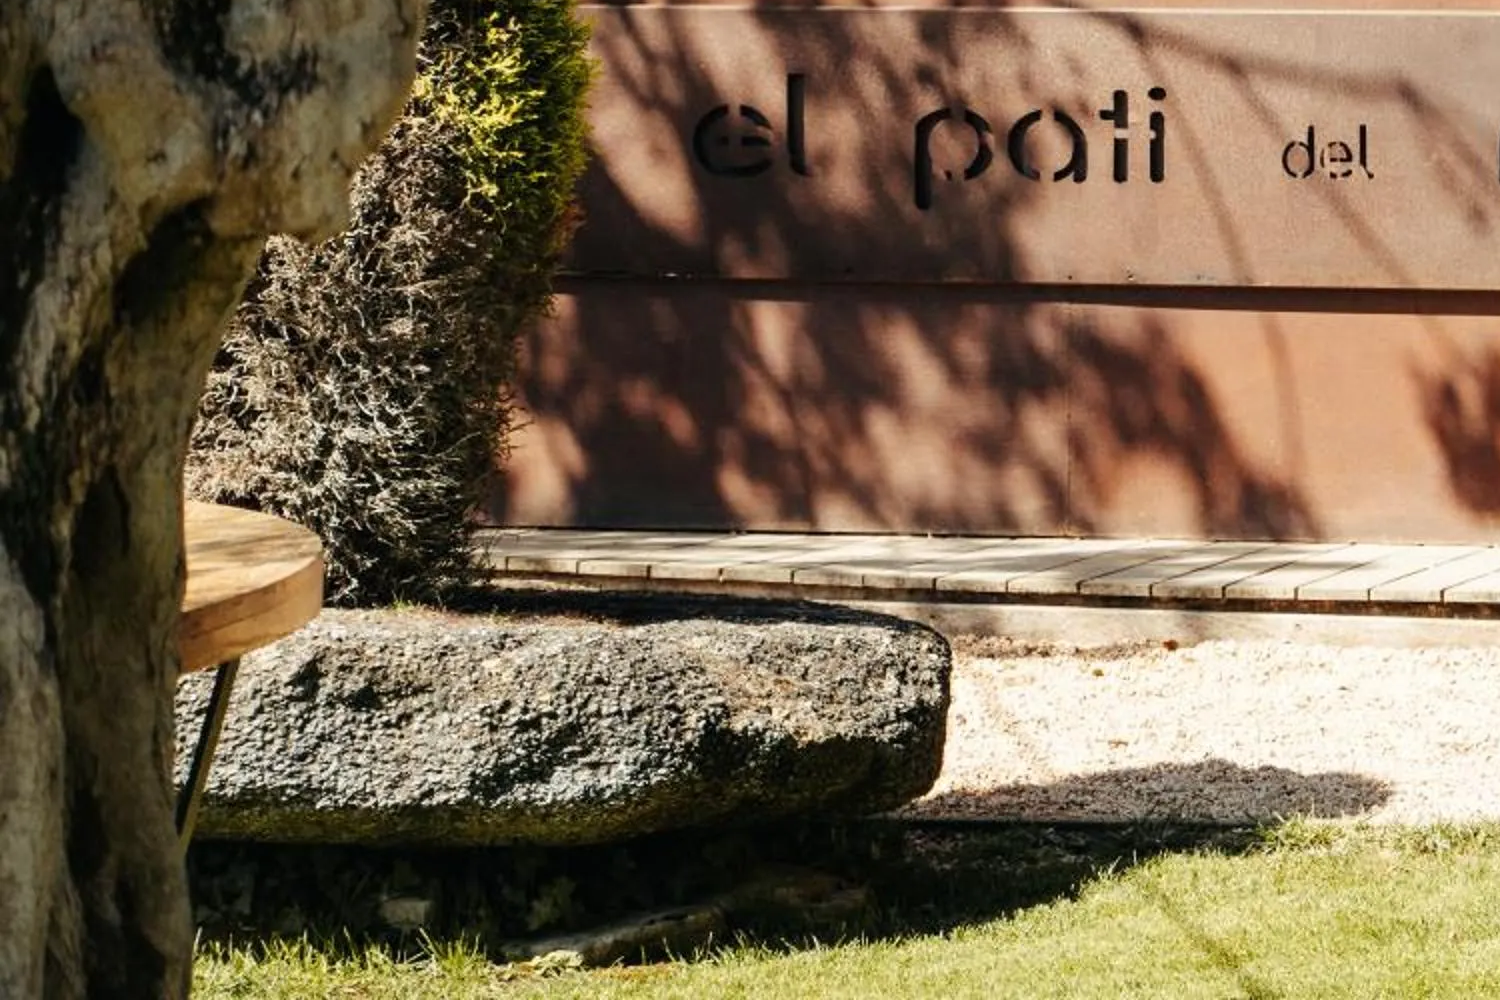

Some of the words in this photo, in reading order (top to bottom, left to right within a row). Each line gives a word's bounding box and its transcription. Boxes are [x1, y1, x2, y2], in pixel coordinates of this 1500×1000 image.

[692, 73, 814, 178] el
[914, 86, 1167, 211] pati
[1281, 123, 1375, 180] del
